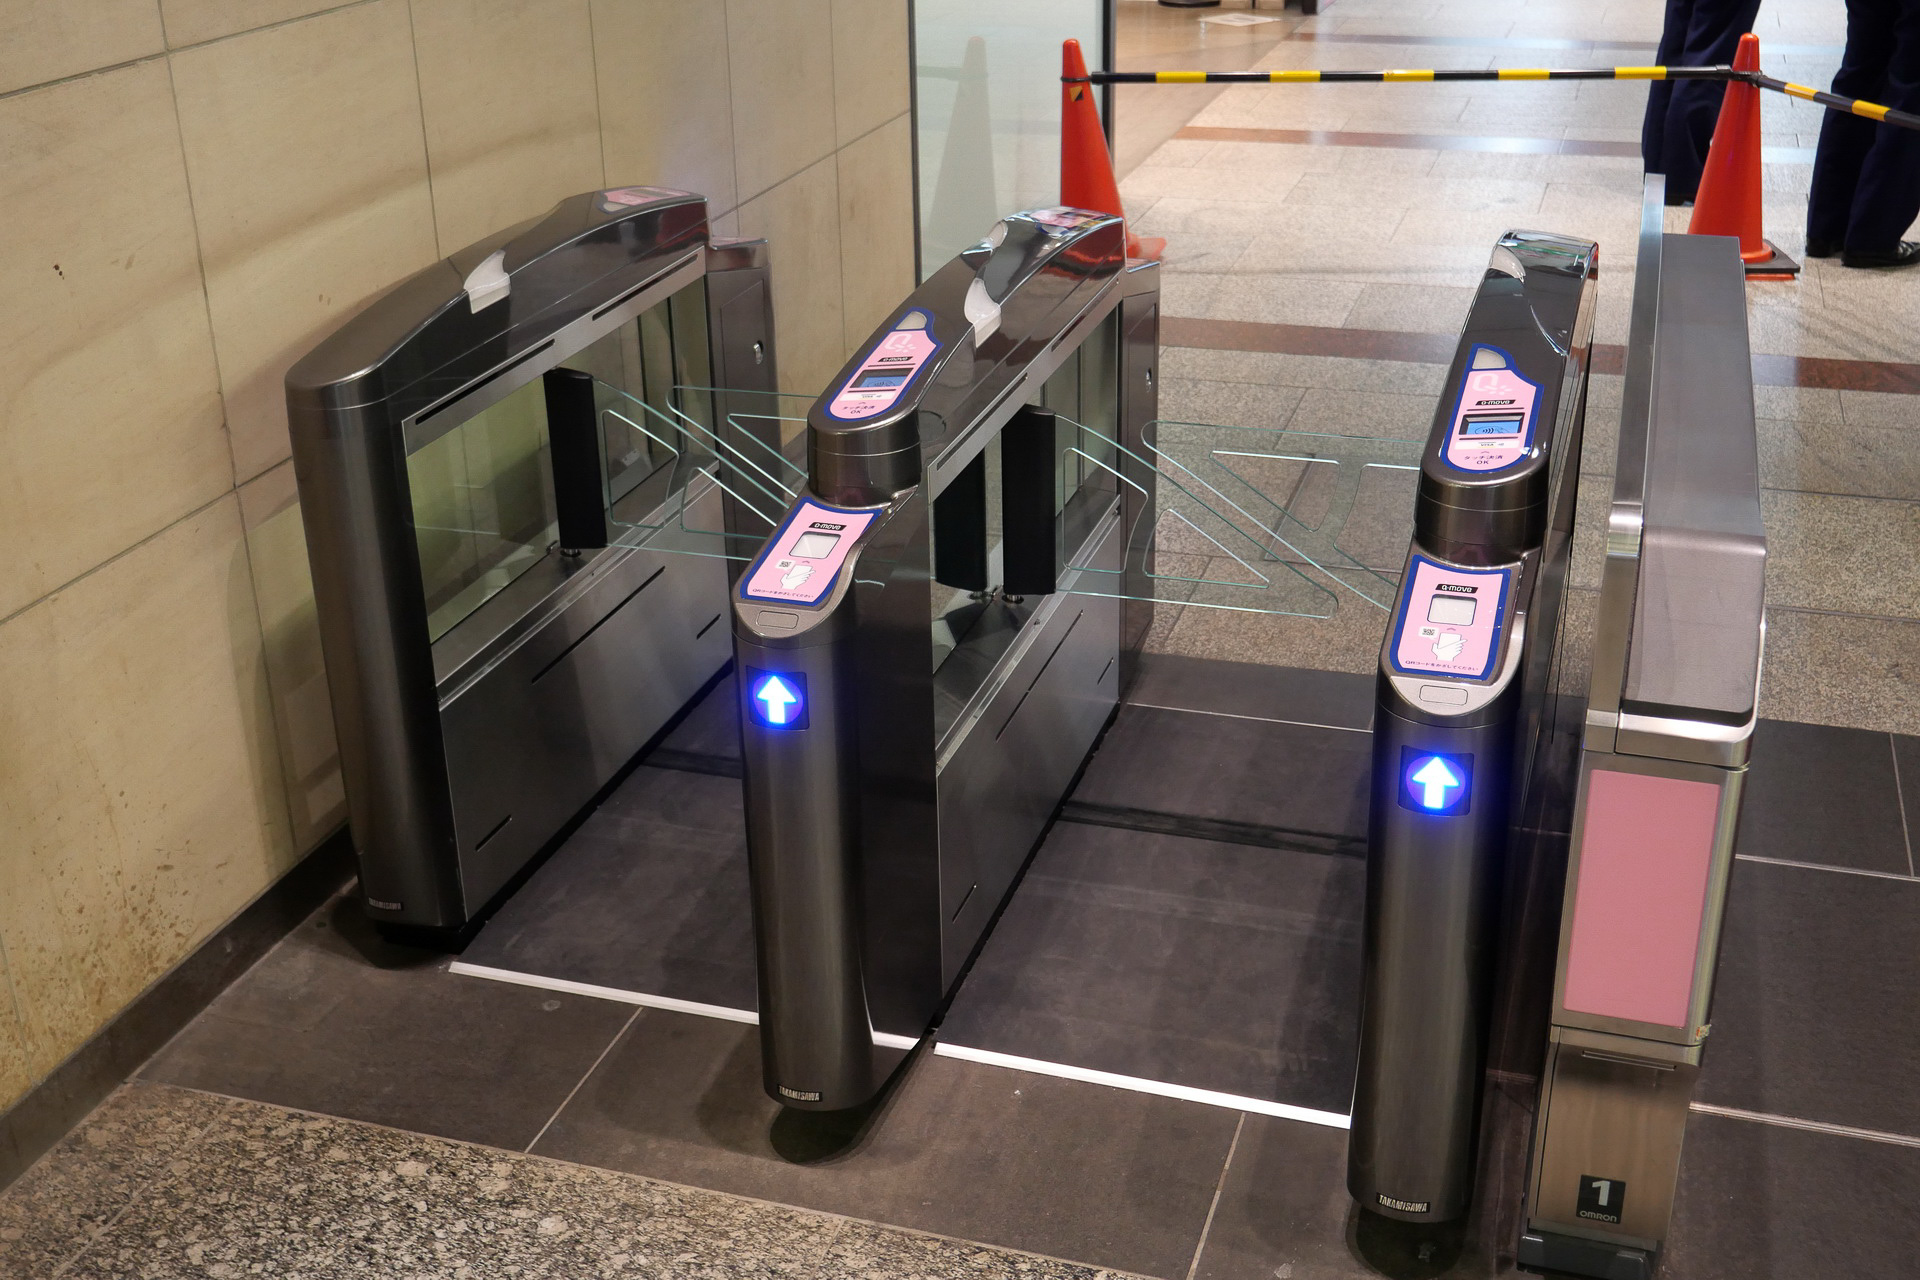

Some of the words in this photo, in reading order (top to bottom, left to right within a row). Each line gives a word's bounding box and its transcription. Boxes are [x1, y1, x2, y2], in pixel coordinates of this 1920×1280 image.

[779, 1085, 820, 1101] TAKAMISAWA
[1592, 1180, 1611, 1206] 1
[1379, 1194, 1427, 1212] TAKAMISAWA
[1579, 1210, 1618, 1223] OMRON
